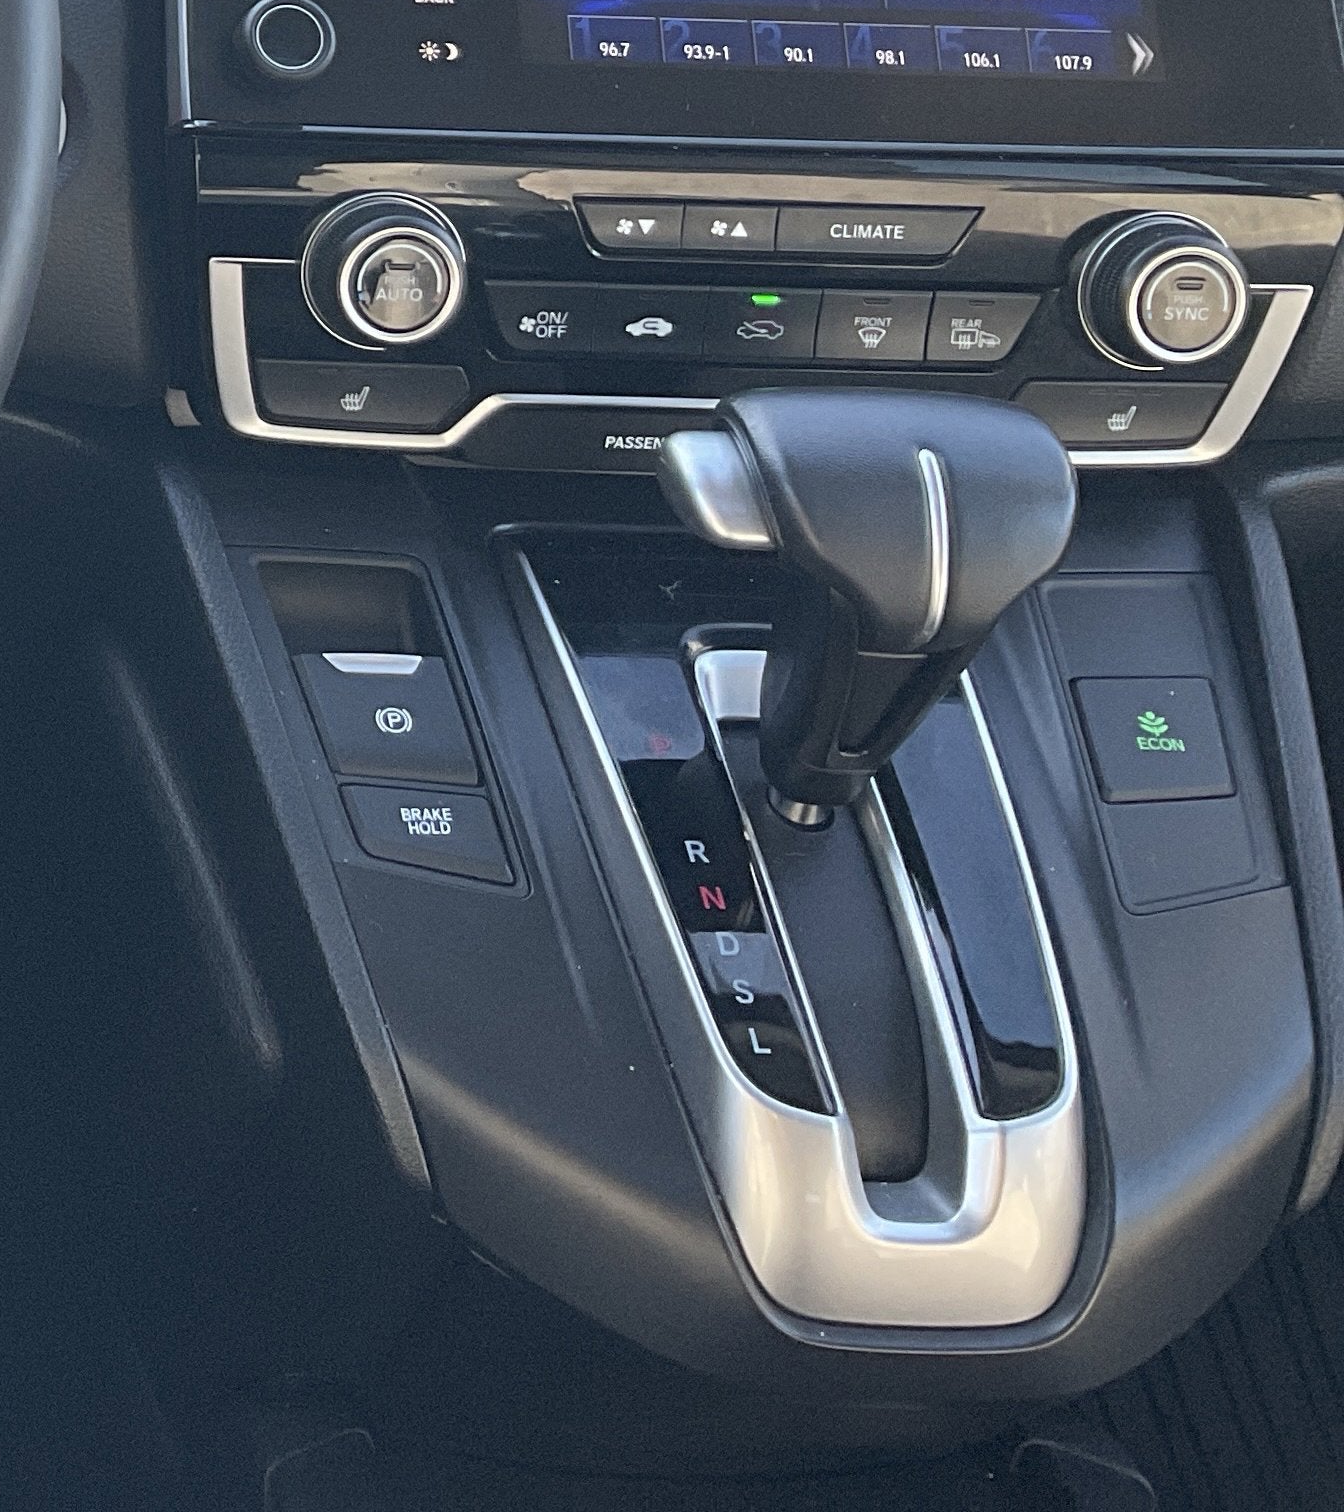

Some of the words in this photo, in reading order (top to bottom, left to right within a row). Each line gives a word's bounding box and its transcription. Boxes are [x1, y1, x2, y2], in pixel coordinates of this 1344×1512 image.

[599, 42, 630, 58] 96.7
[683, 44, 730, 60] 93.9-1
[783, 47, 814, 63] 90.1
[875, 50, 906, 66] 98.1
[963, 52, 1001, 69] 106.1
[1054, 55, 1093, 71] 107.9
[830, 224, 905, 240] CLIMATE
[375, 287, 423, 302] AUTO
[1174, 295, 1203, 305] PUSH
[536, 311, 568, 326] ON/
[1163, 306, 1209, 322] SYNC
[854, 317, 891, 328] FRONT
[952, 318, 982, 329] REAR
[535, 324, 567, 338] OFF
[1137, 737, 1185, 753] ECON
[400, 807, 453, 822] BRAKE
[408, 821, 452, 836] HOLD
[684, 840, 710, 864] R
[700, 886, 726, 911] N
[718, 932, 740, 957] D
[732, 981, 754, 1004] S
[748, 1029, 772, 1055] L
